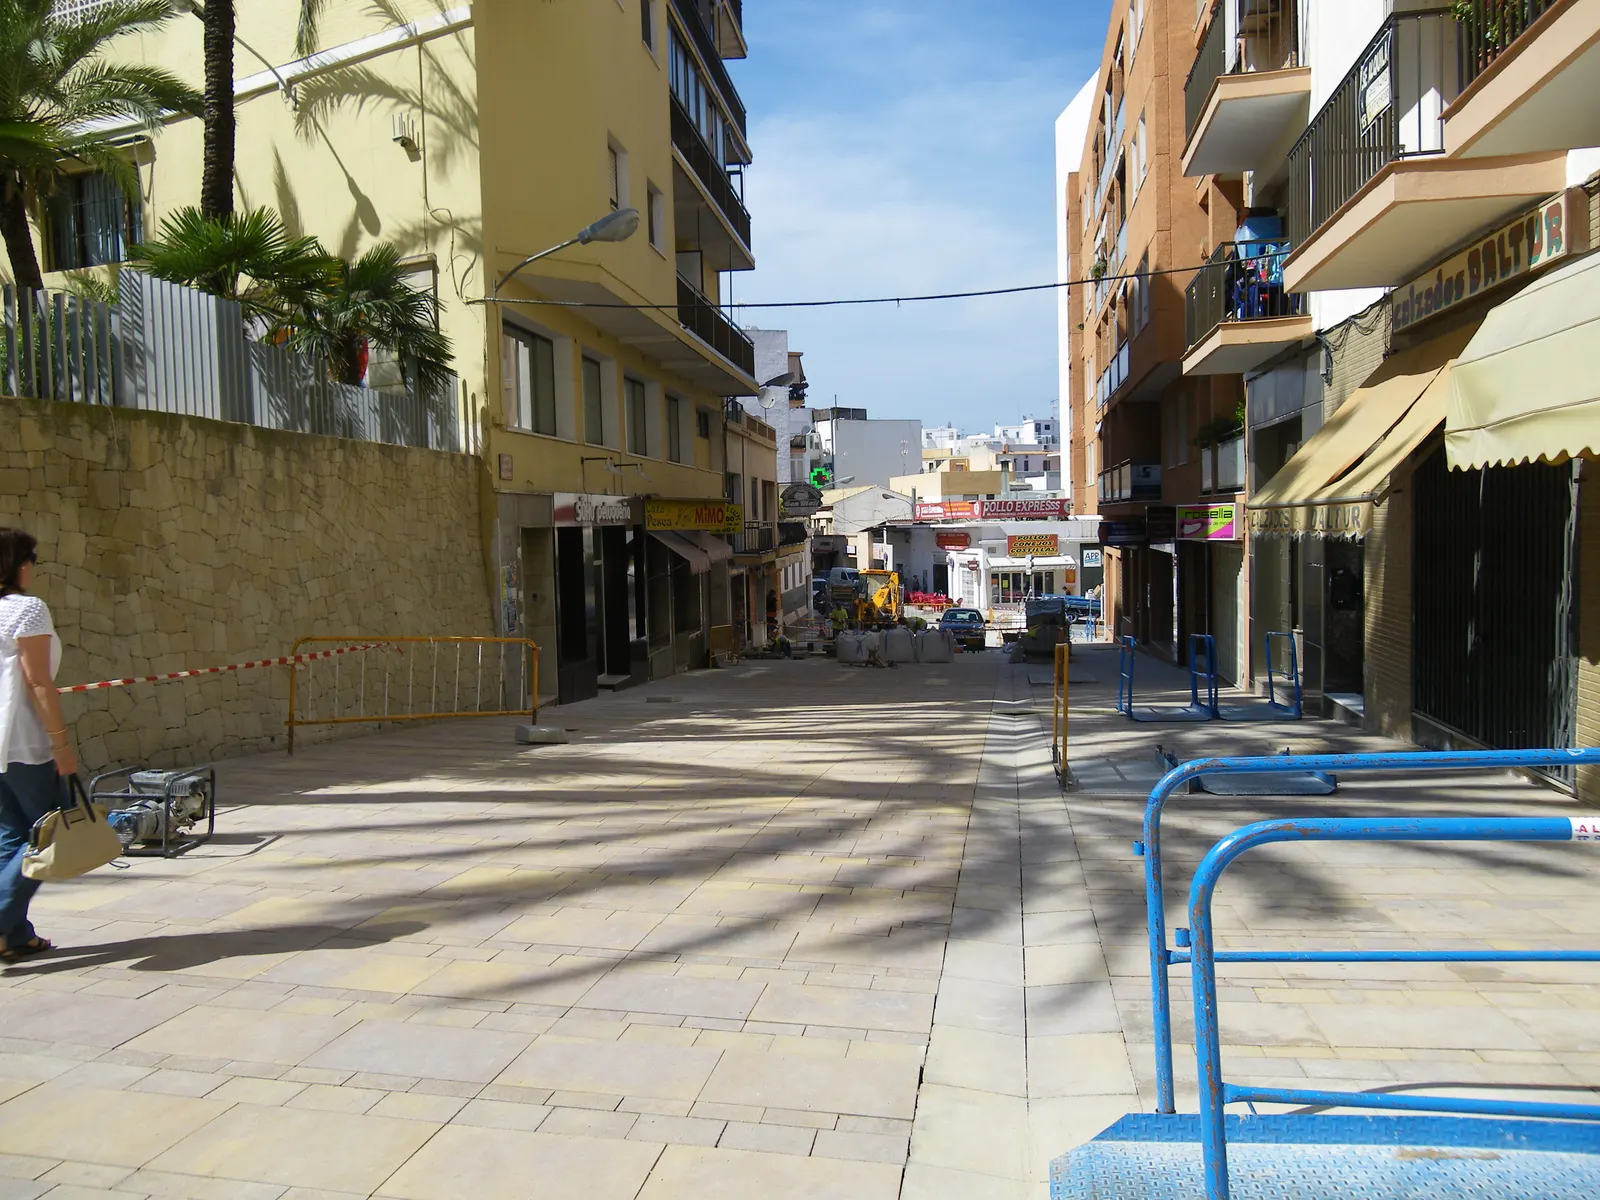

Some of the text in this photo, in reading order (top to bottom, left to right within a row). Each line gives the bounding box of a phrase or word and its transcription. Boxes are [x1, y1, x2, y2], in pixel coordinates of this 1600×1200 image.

[1393, 201, 1563, 331] calzados DALTUR
[982, 501, 1014, 517] POLLO
[1185, 508, 1233, 519] rosella
